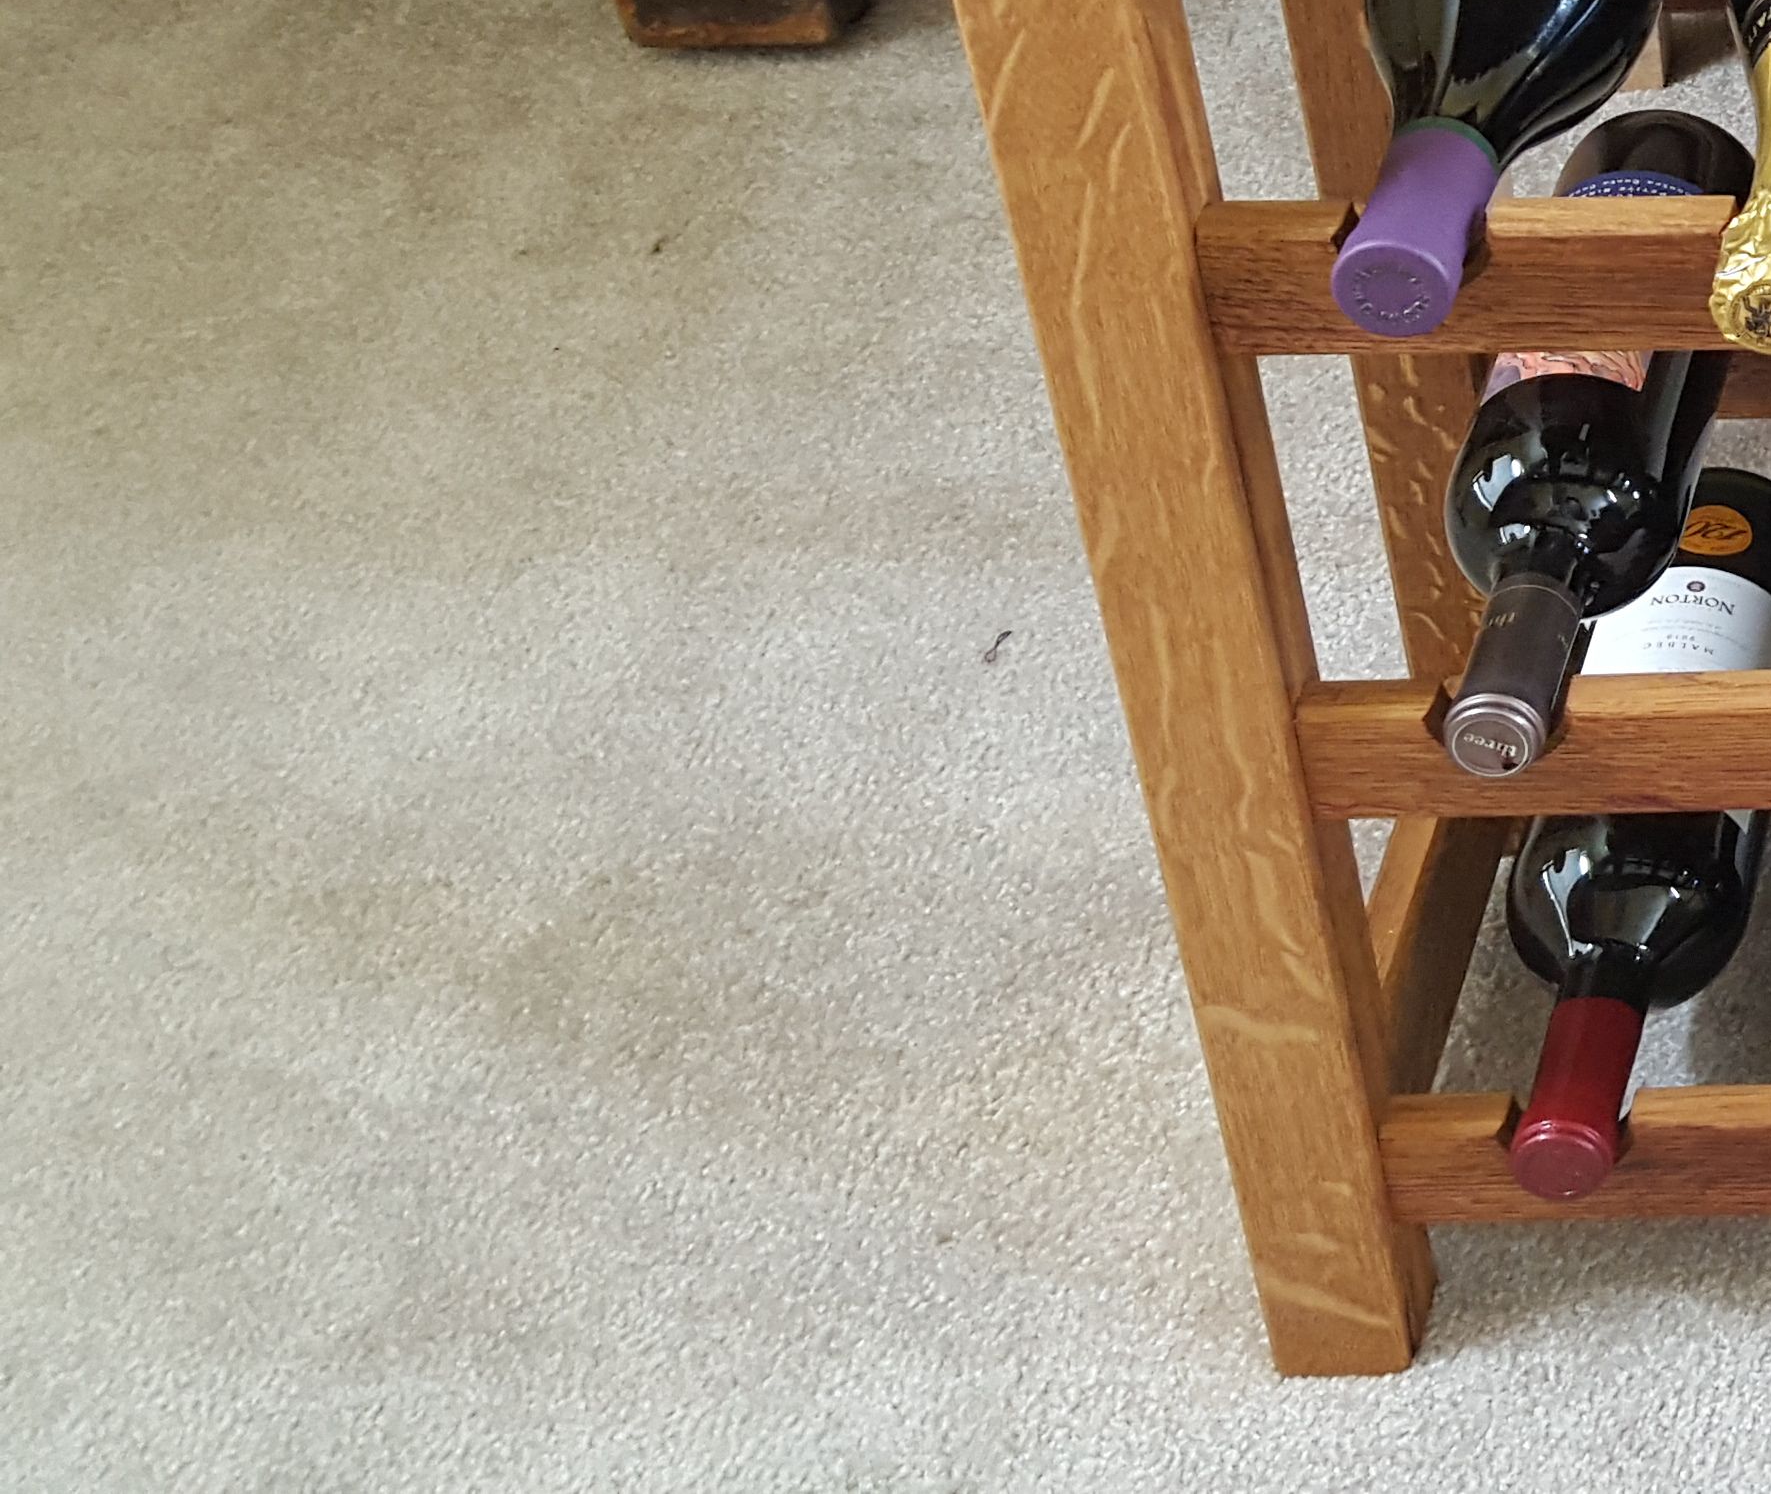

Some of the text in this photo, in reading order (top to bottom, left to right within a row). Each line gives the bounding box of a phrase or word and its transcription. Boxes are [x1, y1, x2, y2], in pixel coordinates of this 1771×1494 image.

[1650, 594, 1736, 617] NORTON
[1643, 642, 1715, 656] MALBEC
[1463, 733, 1518, 759] three
